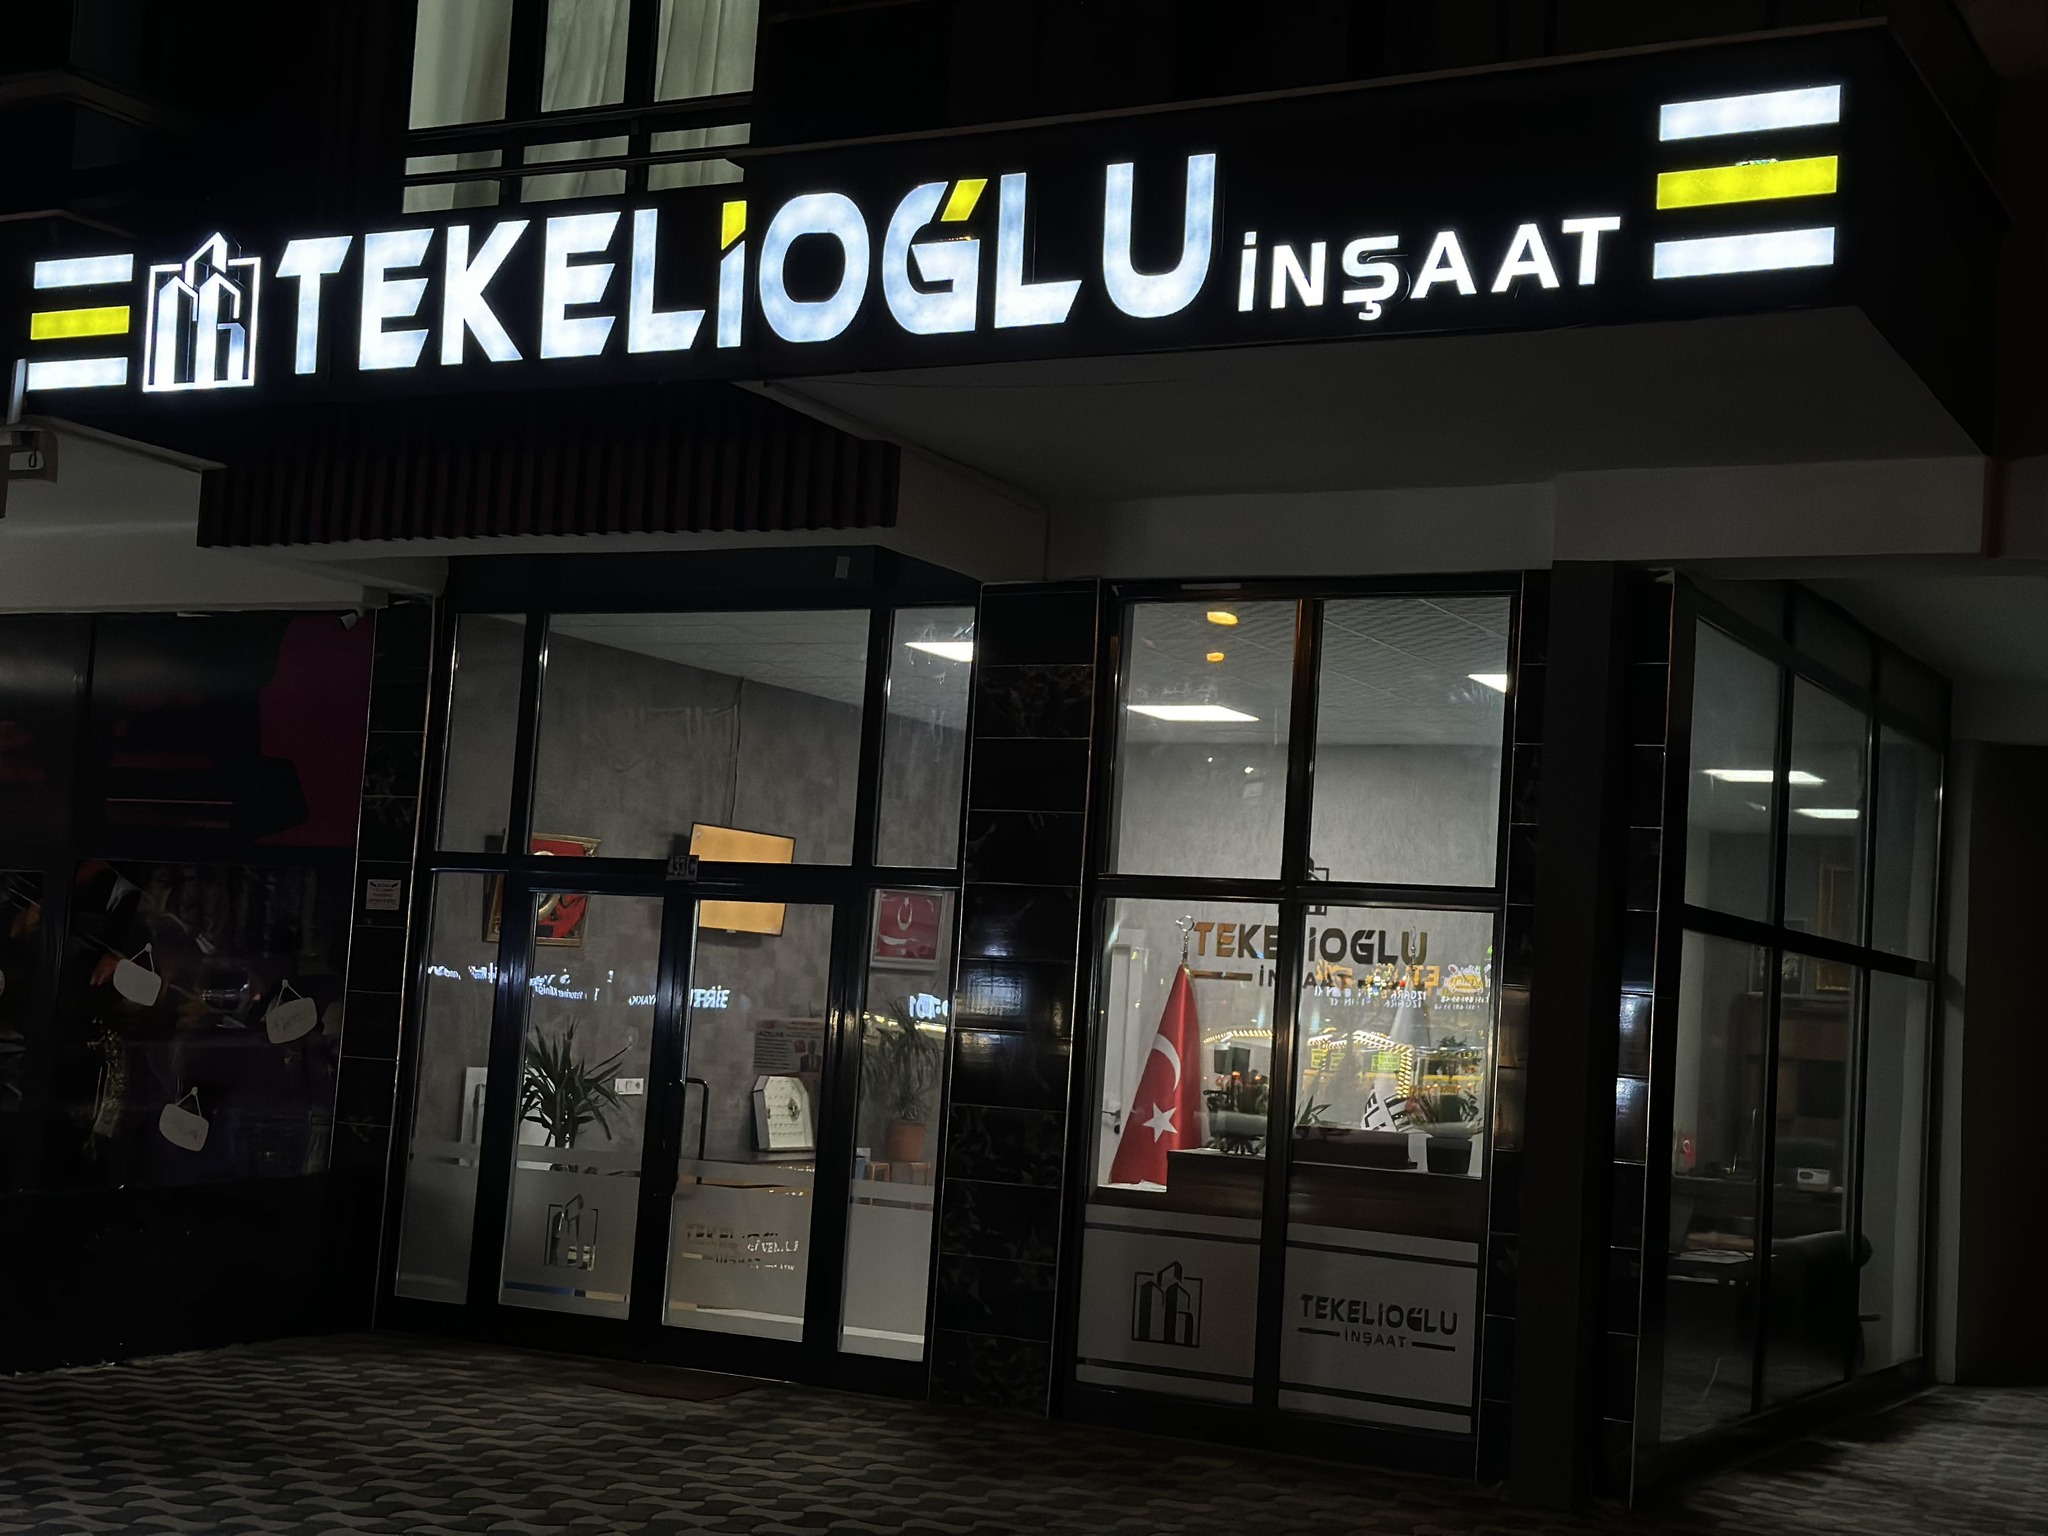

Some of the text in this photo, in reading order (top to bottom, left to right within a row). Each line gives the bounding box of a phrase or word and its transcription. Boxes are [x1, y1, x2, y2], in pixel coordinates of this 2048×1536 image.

[275, 152, 1622, 375] TEKELİOĞLU İNŞAAT
[1193, 921, 1428, 966] TEKEİOĞLU
